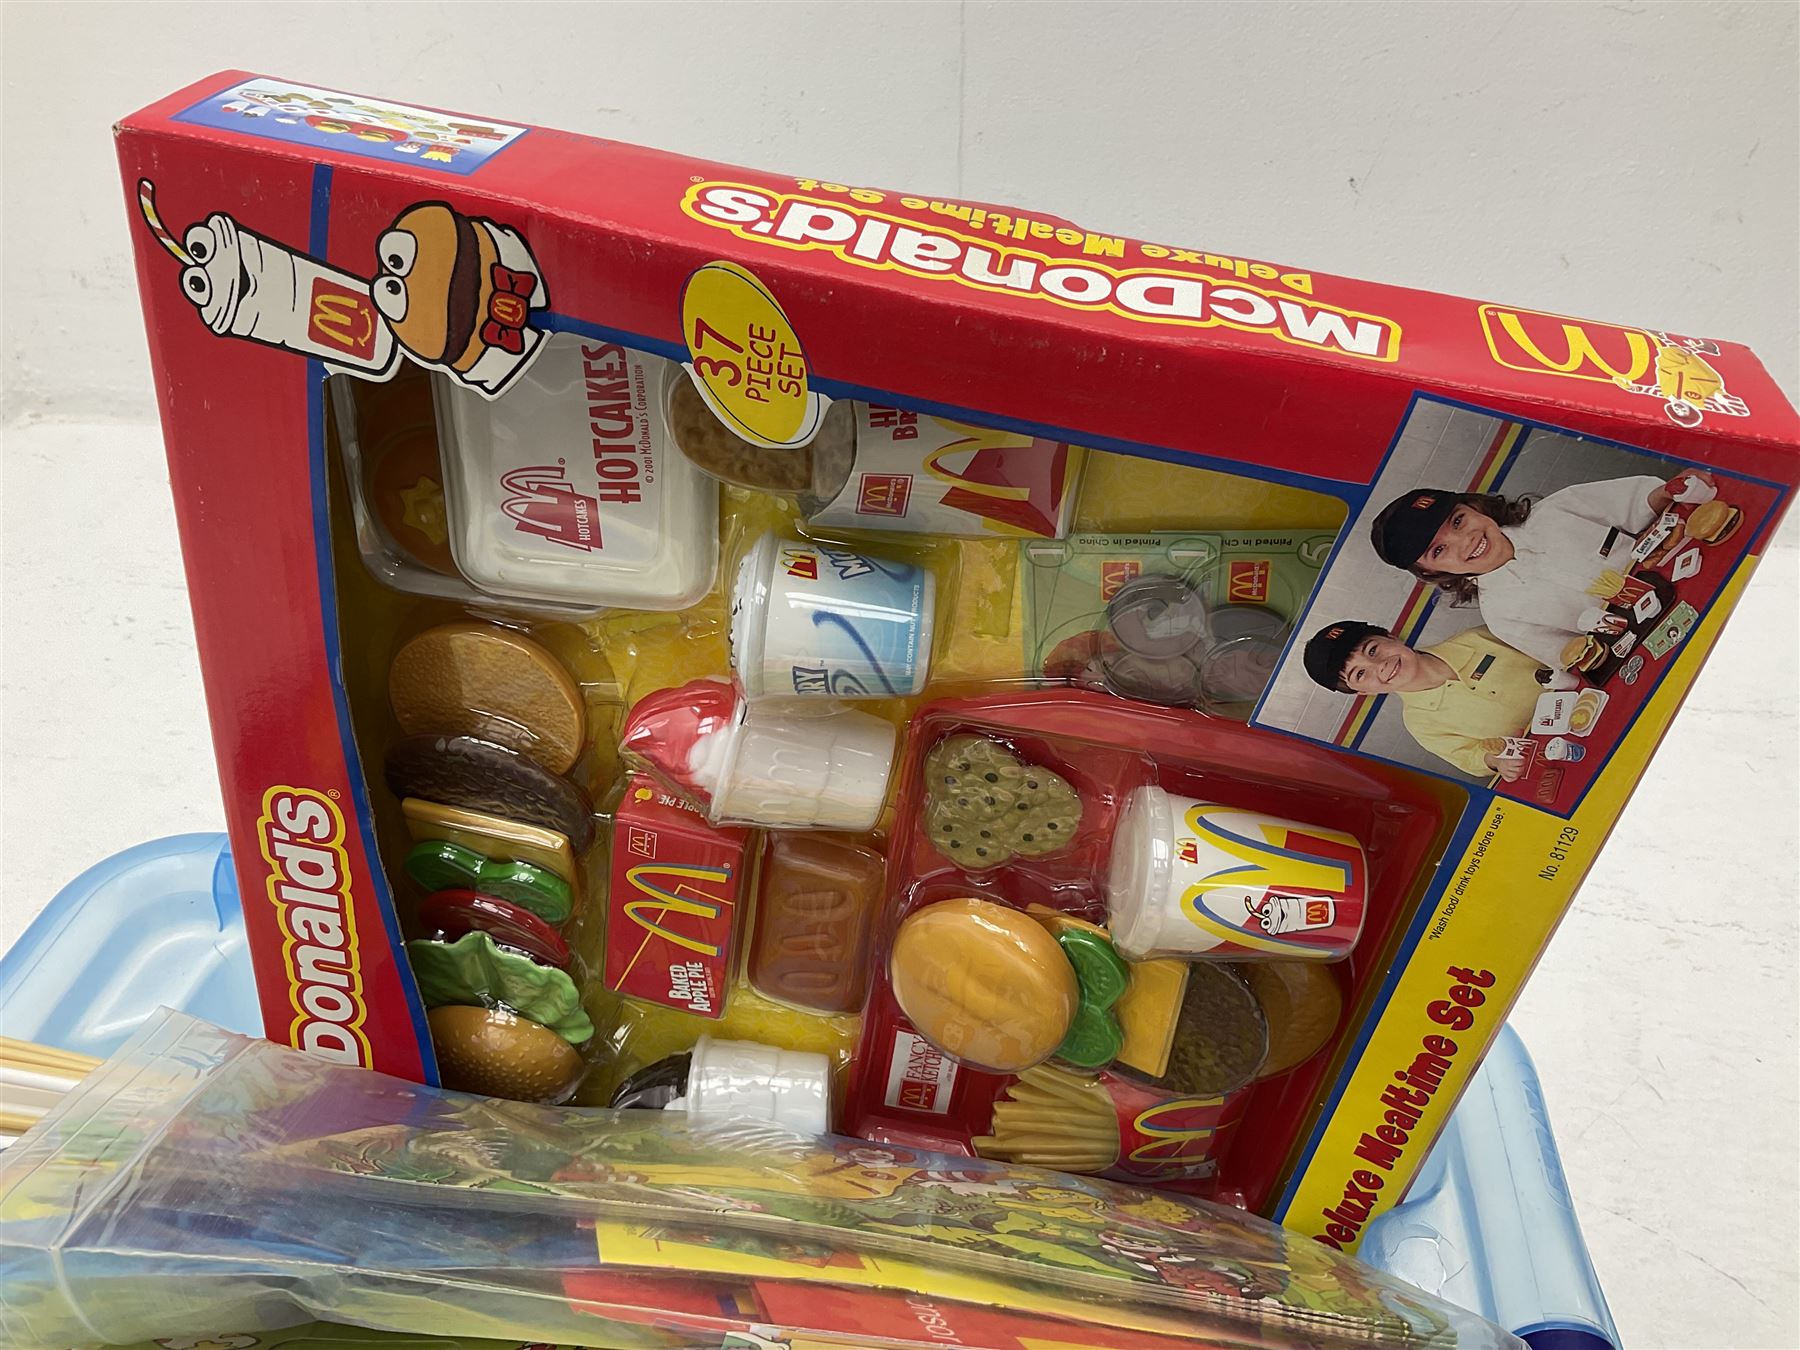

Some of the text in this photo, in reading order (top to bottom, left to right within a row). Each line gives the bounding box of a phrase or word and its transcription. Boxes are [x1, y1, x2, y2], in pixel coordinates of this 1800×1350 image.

[794, 177, 1313, 295] Deluxe Mealtime Set
[699, 188, 1383, 356] McDonald's
[693, 317, 744, 386] 37
[745, 323, 776, 402] PIECE
[777, 342, 804, 398] SET
[581, 343, 641, 504] HOTCAKES
[574, 499, 592, 541] HOTCAKES
[1079, 537, 1161, 547] Printed in China
[1221, 536, 1293, 547] Printed in Chi
[906, 631, 916, 662] CONTAIN
[911, 585, 920, 617] RODUCTS
[658, 794, 676, 807] PIE
[1455, 875, 1471, 896] drink
[1464, 857, 1481, 876] toys
[1473, 830, 1494, 858] before
[1538, 826, 1579, 881] No. 81129
[272, 797, 360, 1066] Donald's
[668, 963, 688, 1000] BAKED
[686, 961, 704, 979] PIE
[688, 979, 712, 1013] APPLE
[906, 1035, 927, 1080] FANCY
[921, 1046, 943, 1083] KETCH
[1353, 1034, 1458, 1171] Mealtime
[1425, 965, 1496, 1032] Set
